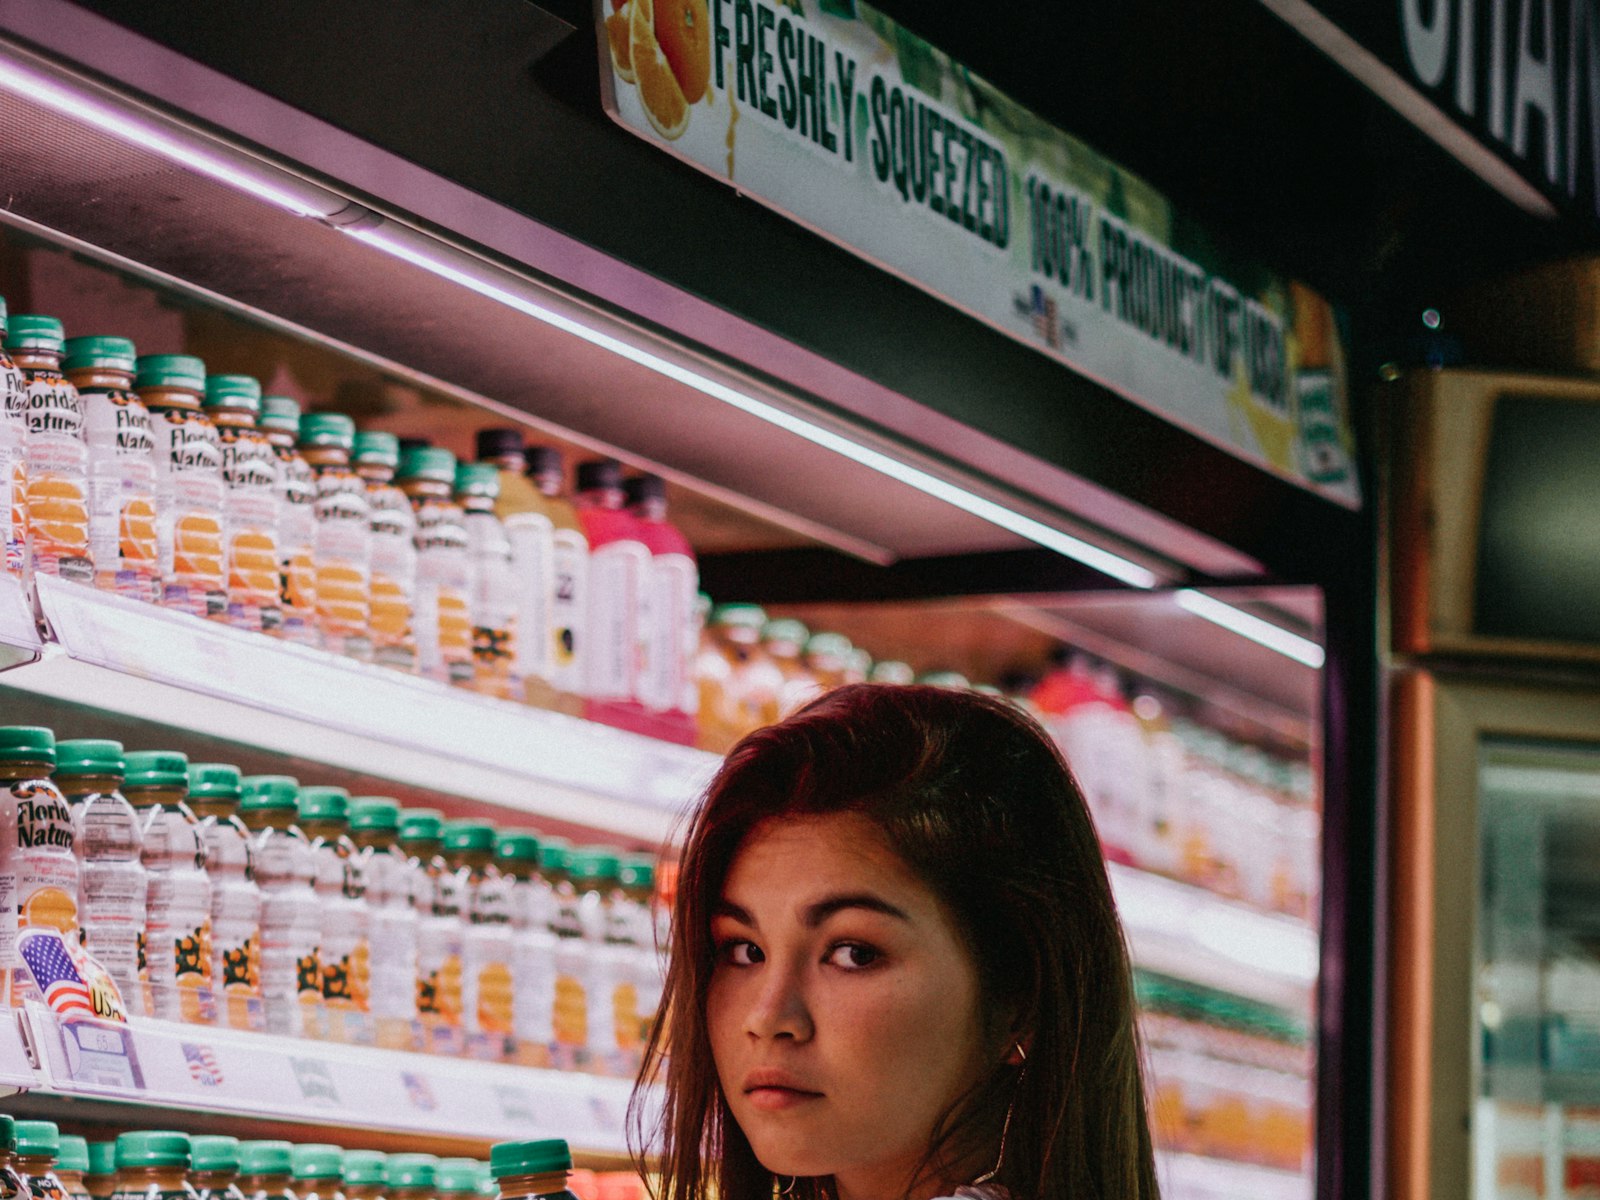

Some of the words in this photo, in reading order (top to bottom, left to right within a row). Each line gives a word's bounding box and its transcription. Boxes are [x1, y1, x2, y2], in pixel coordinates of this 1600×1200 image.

[714, 0, 856, 162] FRESHLY
[871, 75, 1009, 249] SQUEEZED
[92, 987, 121, 1019] USA
